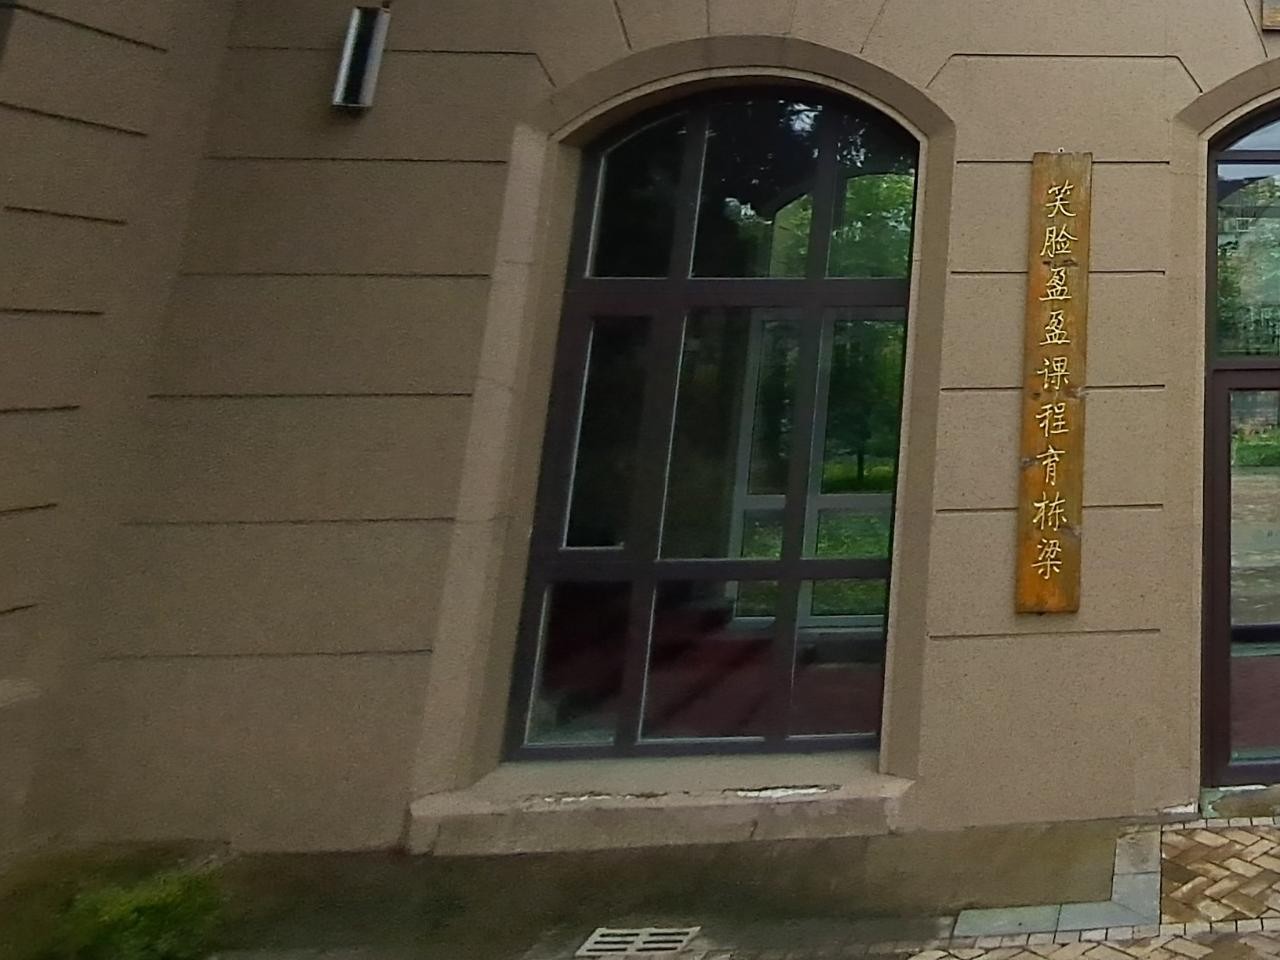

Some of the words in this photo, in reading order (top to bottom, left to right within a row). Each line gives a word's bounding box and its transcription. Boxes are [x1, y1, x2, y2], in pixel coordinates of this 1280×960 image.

[1030, 179, 1079, 580] 笑脸盈盈课程育栋梁
